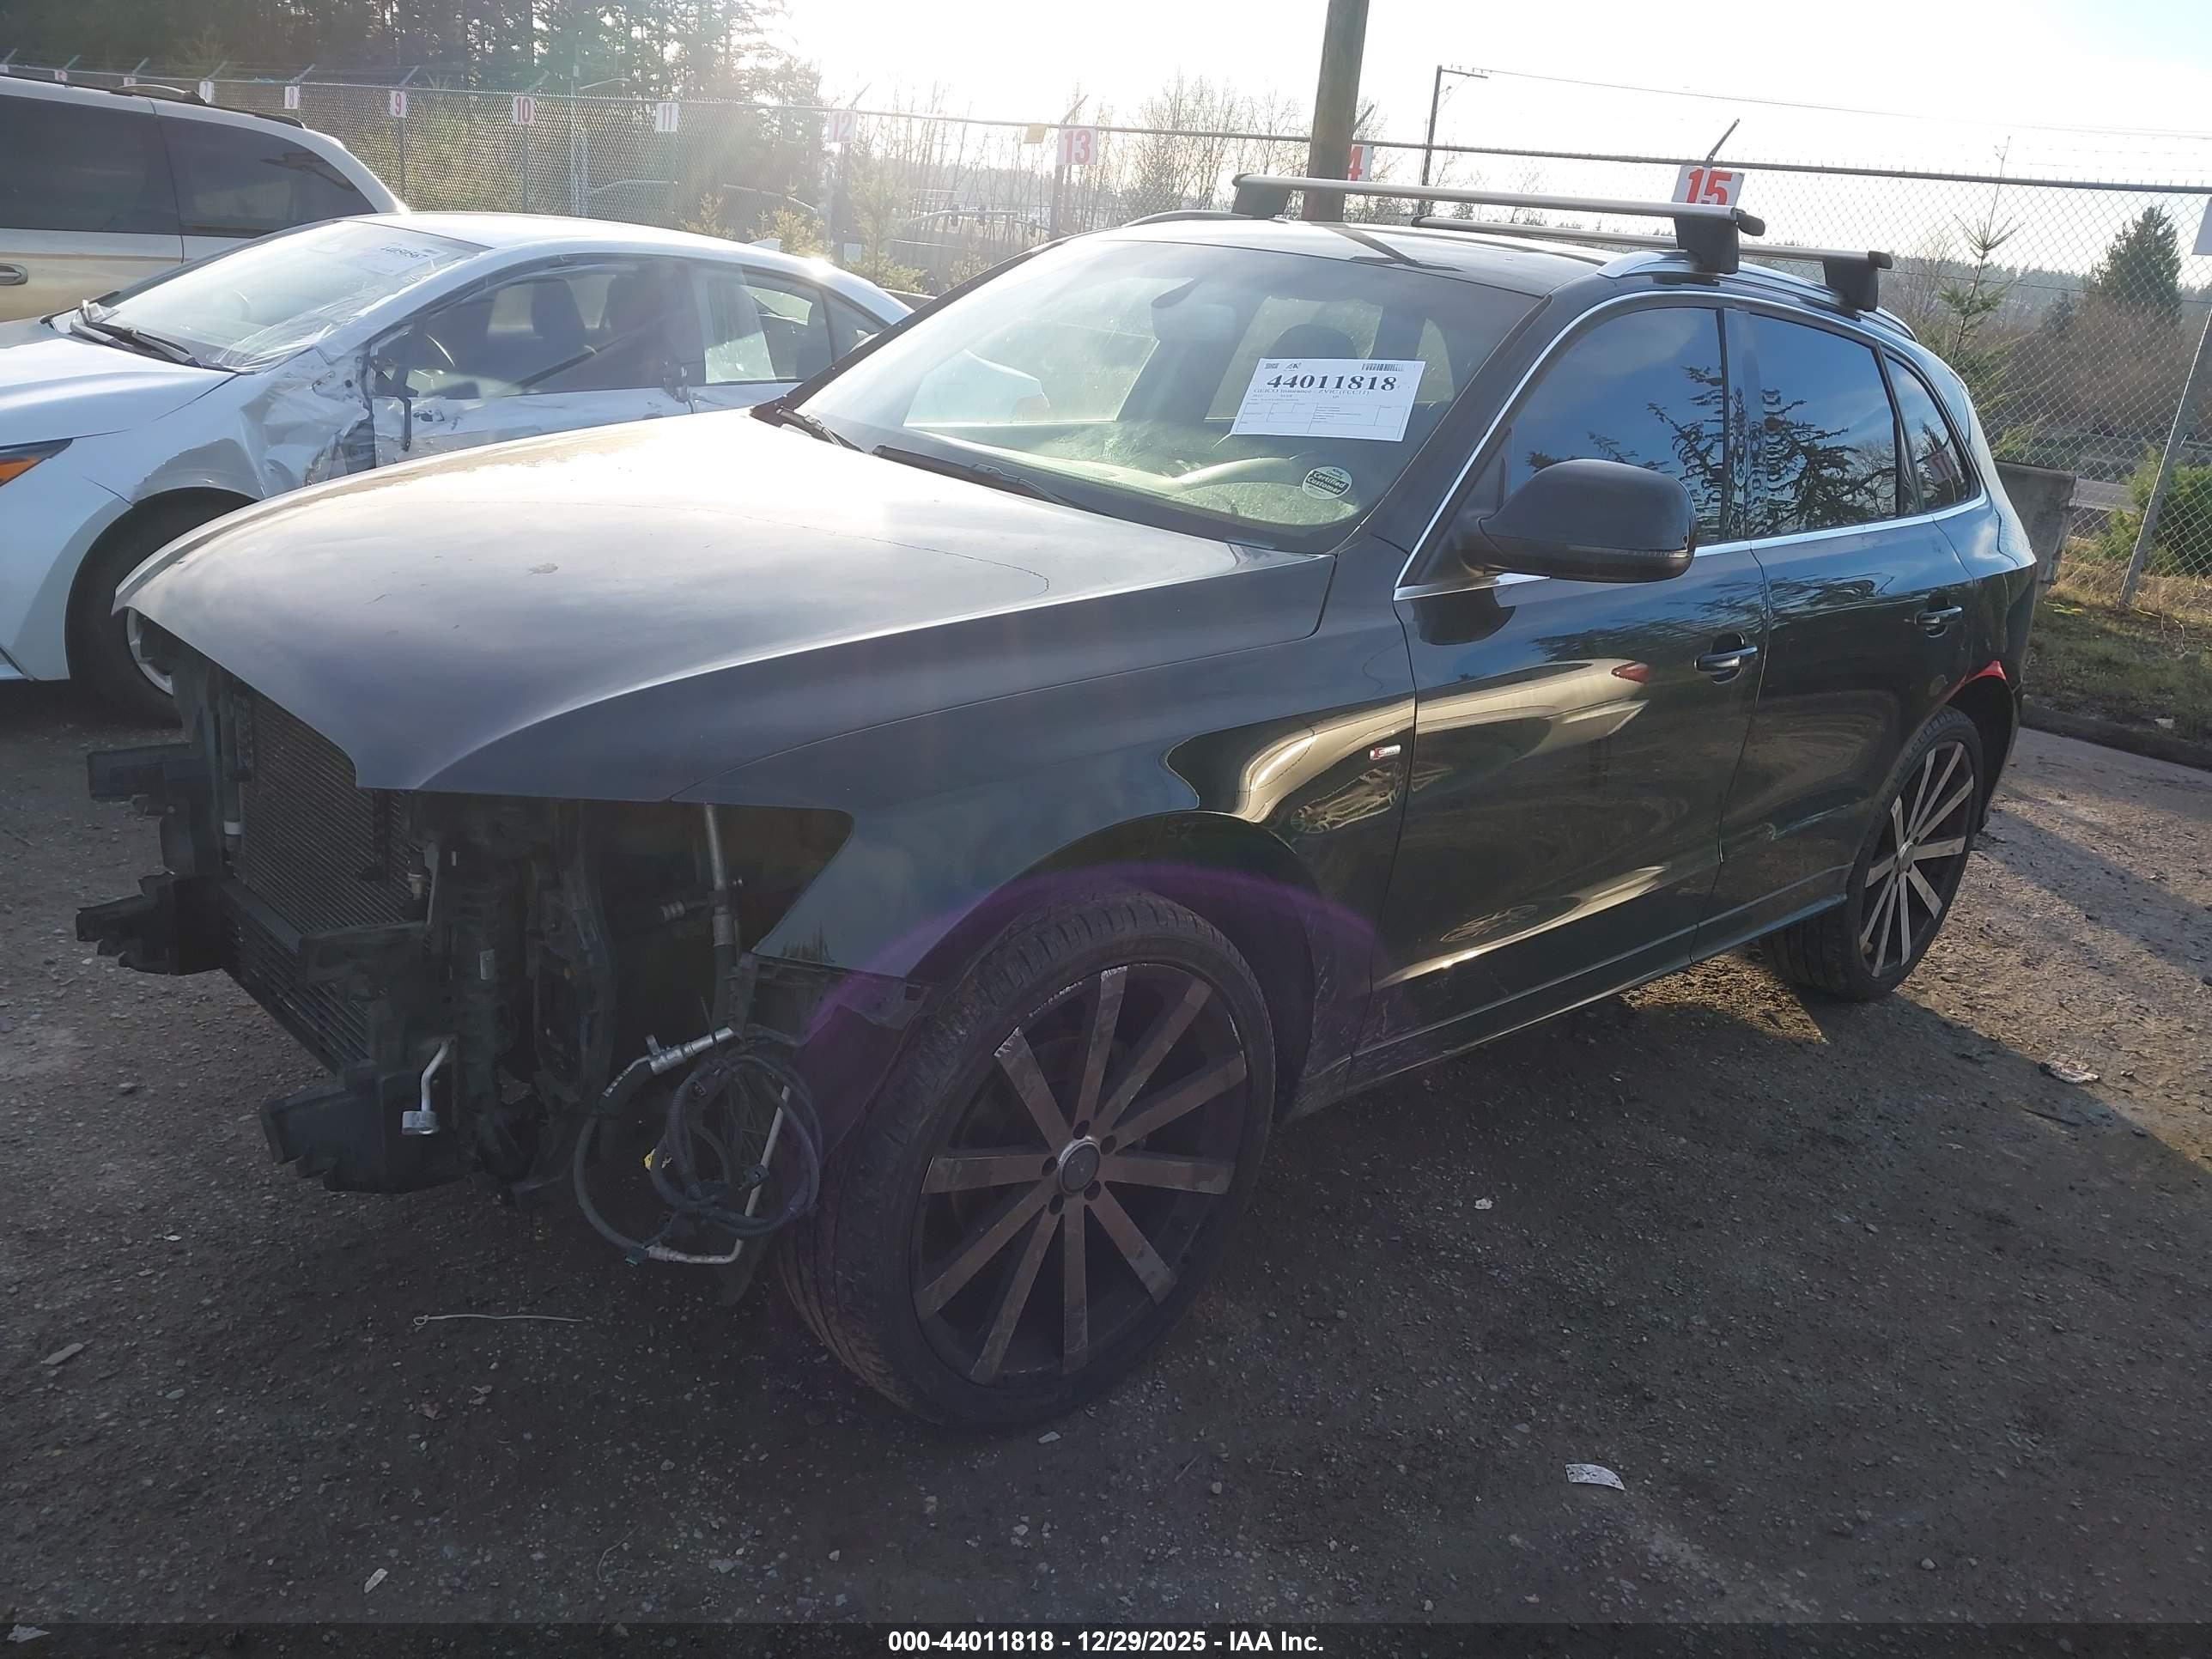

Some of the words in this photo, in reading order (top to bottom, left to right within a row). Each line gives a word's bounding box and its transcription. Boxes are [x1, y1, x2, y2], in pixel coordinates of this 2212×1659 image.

[395, 94, 402, 116] 9
[515, 97, 532, 122] 10
[661, 104, 674, 131] 11
[834, 112, 853, 142] 12
[1065, 130, 1091, 164] 13
[1686, 169, 1733, 205] 15
[1267, 374, 1397, 391] 44011818
[1308, 477, 1343, 494] Customer
[1314, 472, 1347, 489] Certified
